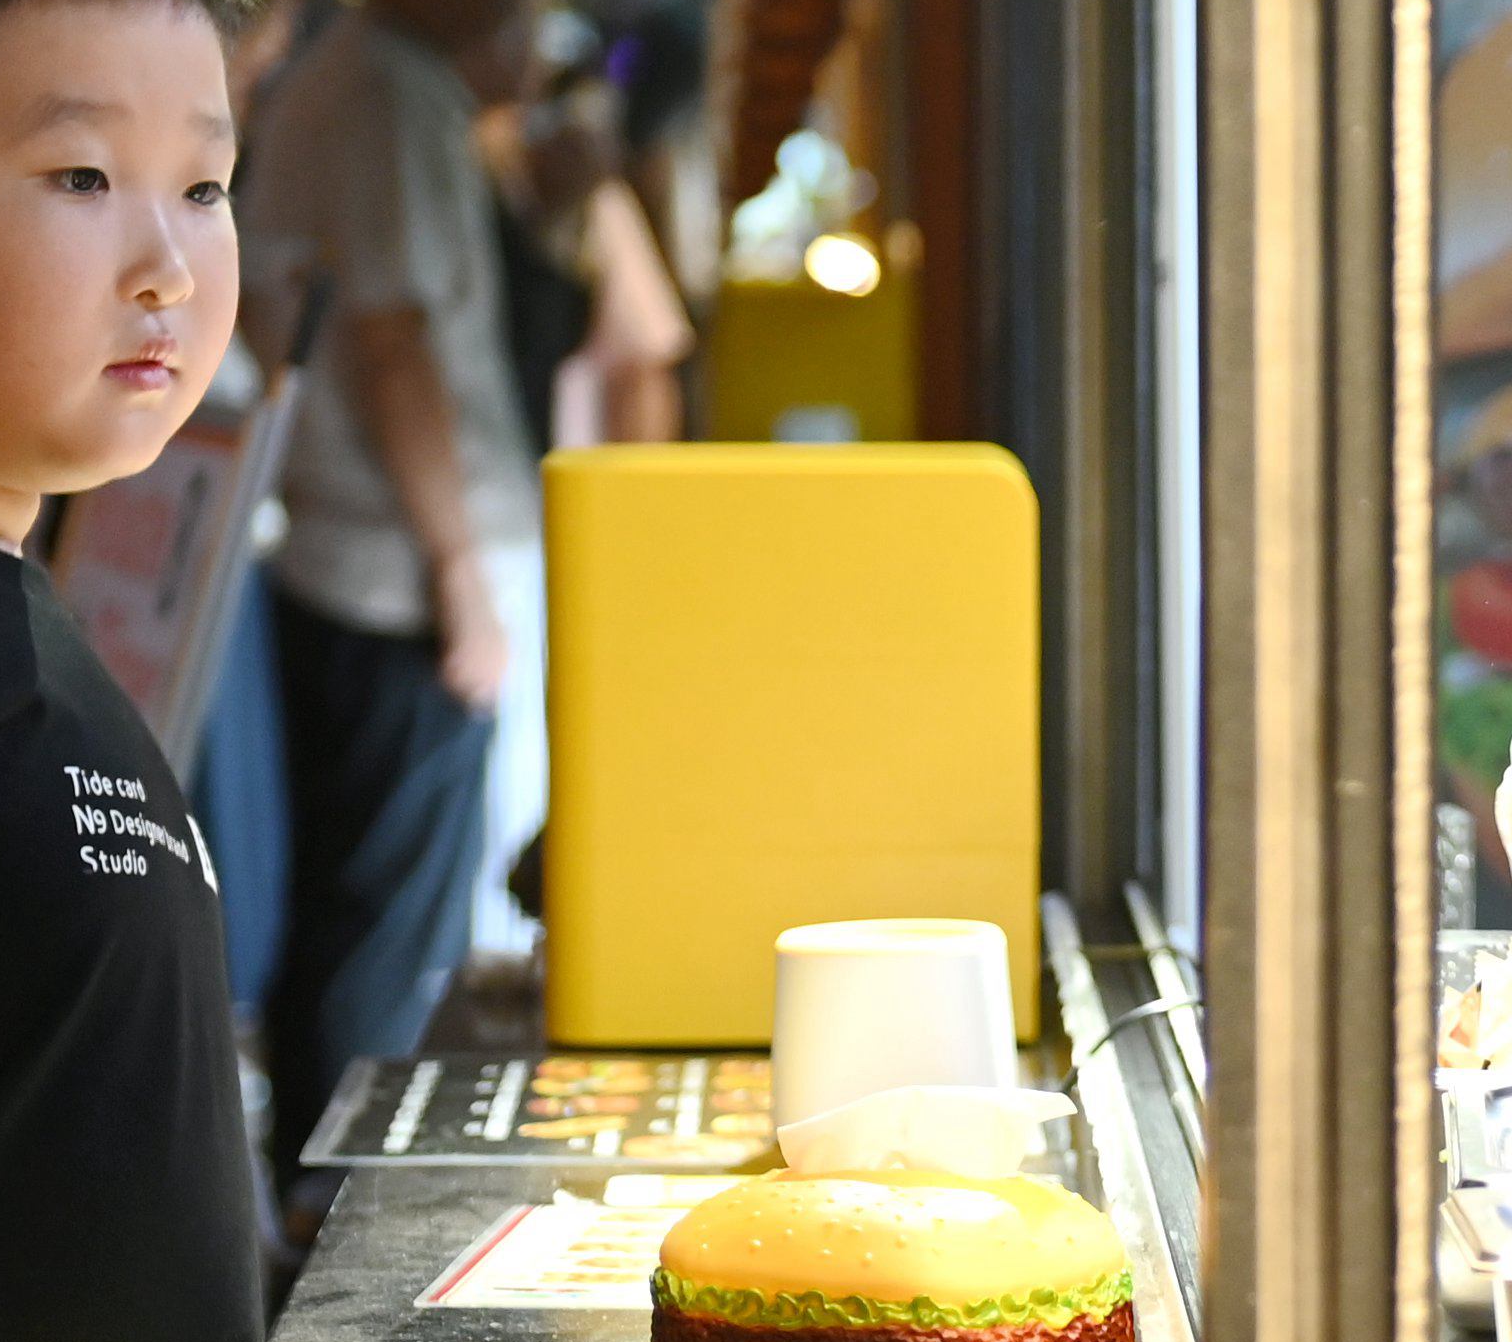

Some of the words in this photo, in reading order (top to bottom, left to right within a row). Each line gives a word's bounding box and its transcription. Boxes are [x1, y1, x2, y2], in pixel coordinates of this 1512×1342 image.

[64, 766, 113, 797] Tide
[116, 777, 146, 802] card
[72, 804, 106, 835] N9
[80, 845, 147, 877] Studio
